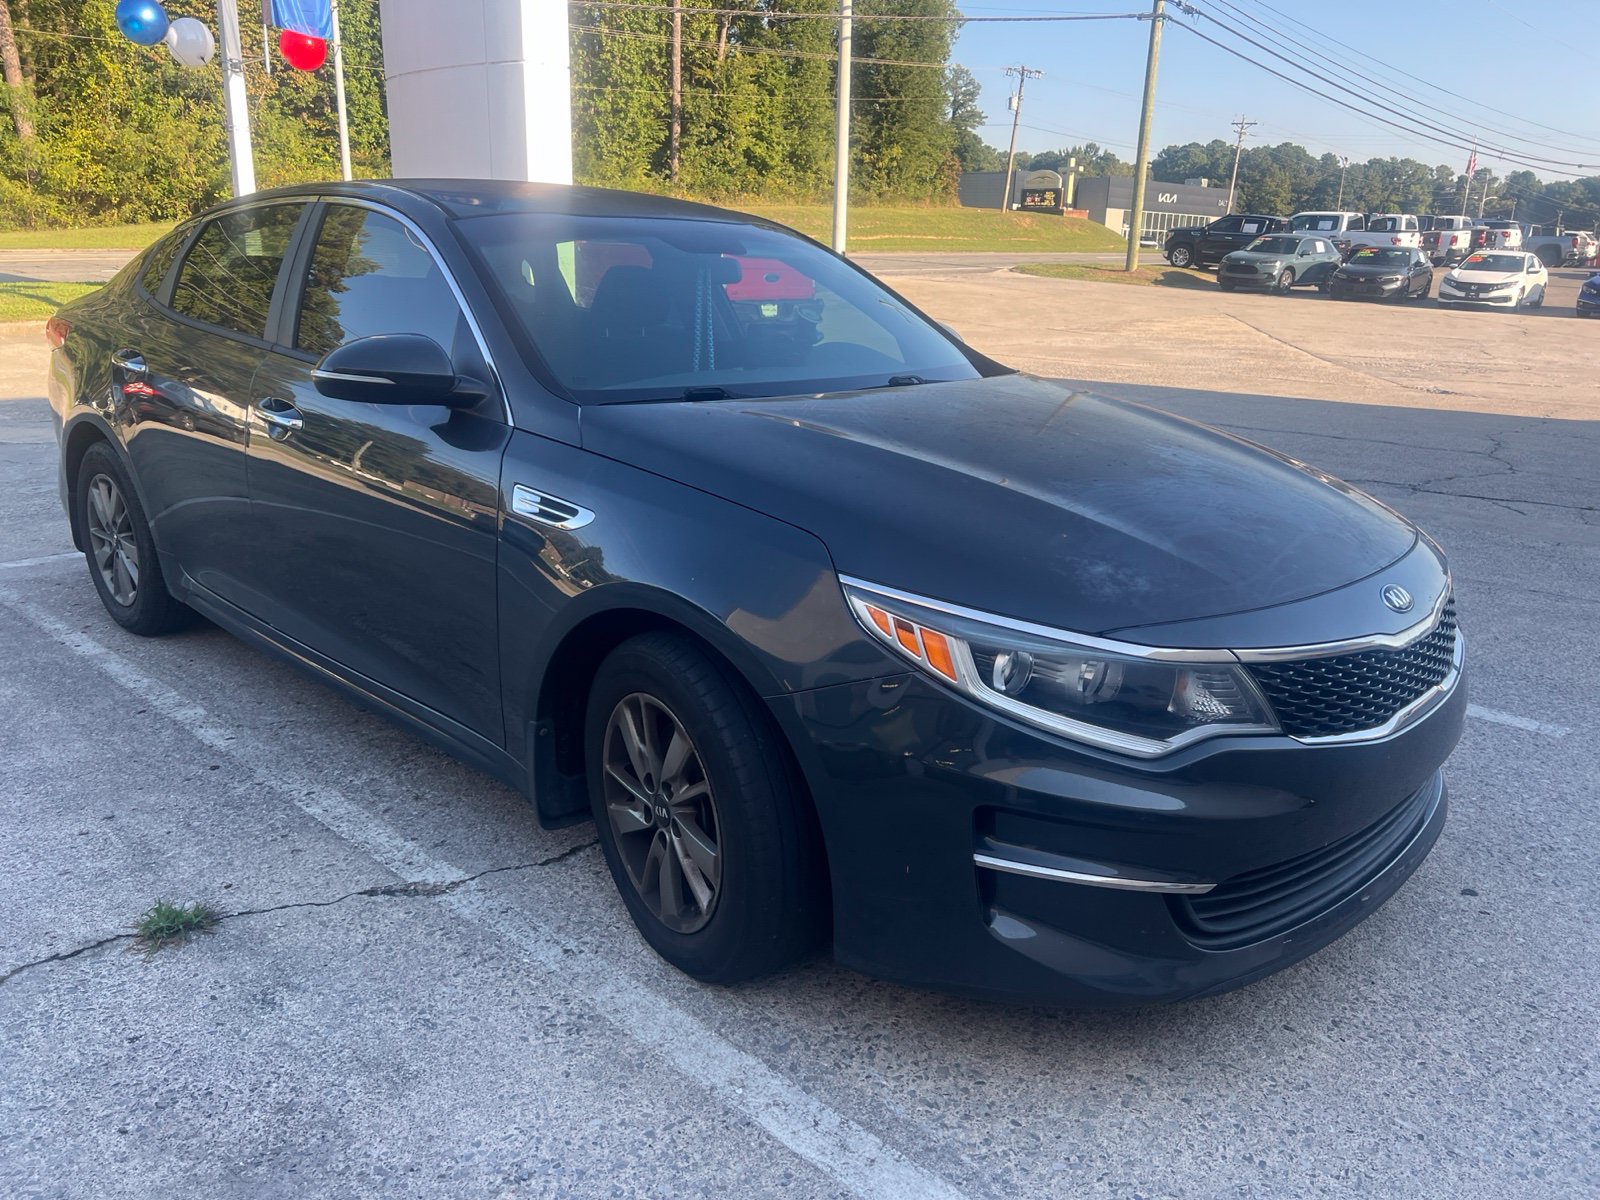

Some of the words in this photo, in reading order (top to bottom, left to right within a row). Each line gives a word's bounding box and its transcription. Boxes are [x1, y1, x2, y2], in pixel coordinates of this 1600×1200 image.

[1158, 193, 1178, 203] KIA
[1385, 586, 1411, 608] KIA
[655, 805, 669, 819] KIA
